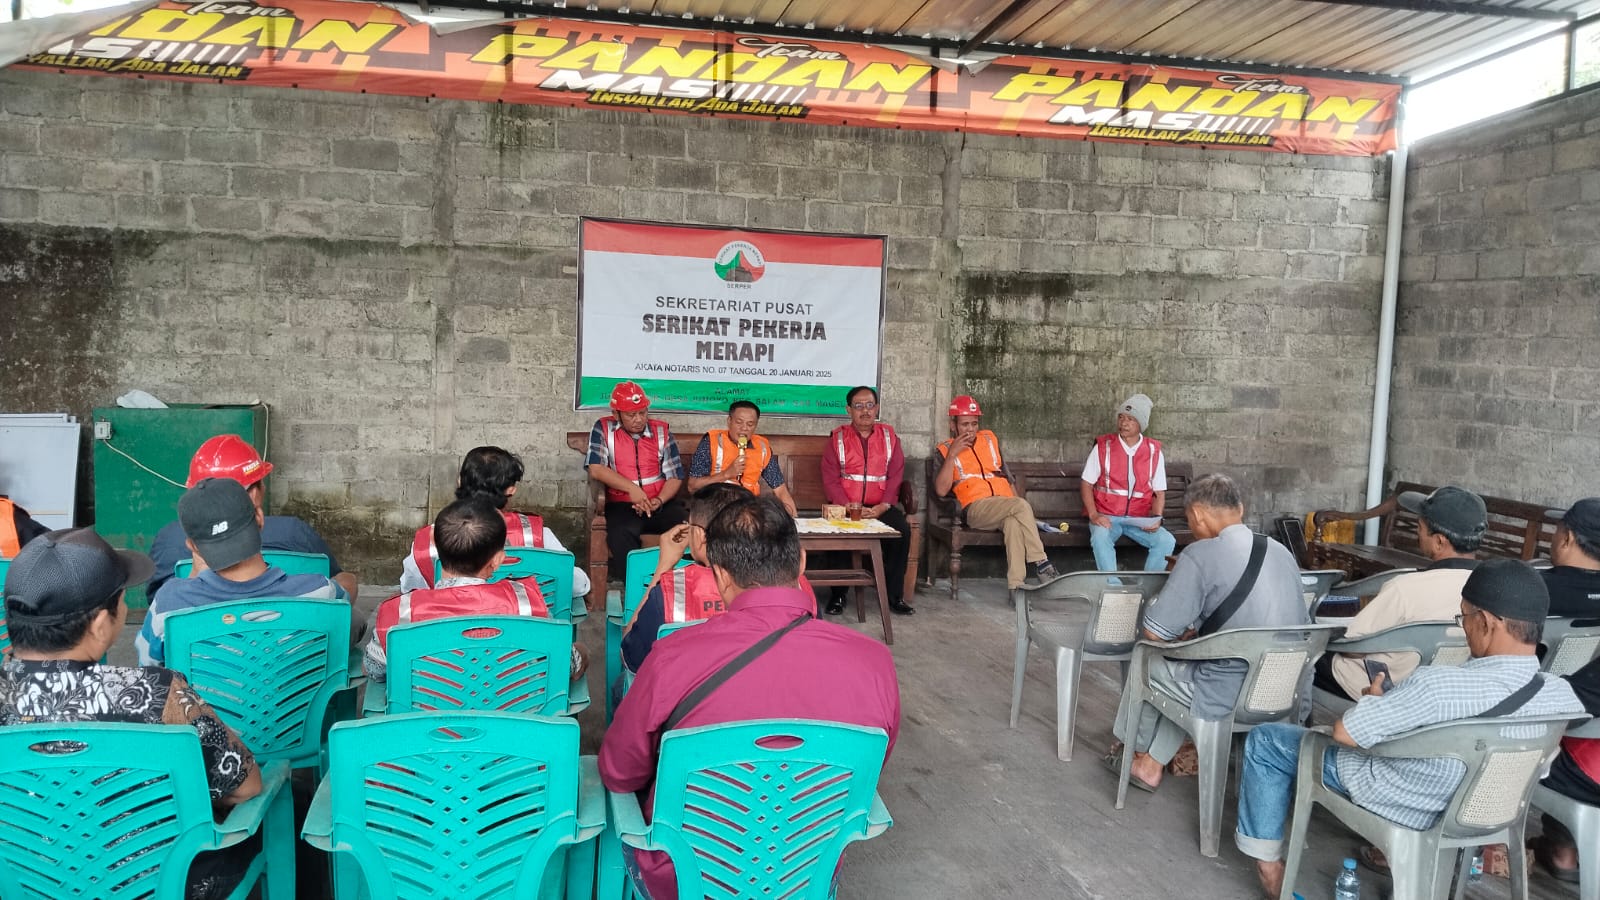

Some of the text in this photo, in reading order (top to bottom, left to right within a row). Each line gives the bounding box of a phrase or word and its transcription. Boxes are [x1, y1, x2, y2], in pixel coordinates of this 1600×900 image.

[88, 8, 397, 53] DAN
[738, 37, 843, 60] Team
[470, 33, 932, 93] PANDAN
[1217, 75, 1305, 93] Team
[992, 73, 1379, 123] PANDAN
[656, 296, 813, 315] SEKRETARIAT PUSAT
[642, 313, 827, 340] SERIKAT PEKERJA
[696, 340, 775, 362] MERAPI
[664, 364, 700, 372] NOTARIS
[729, 367, 767, 375] TANGGAL
[703, 600, 724, 611] PE
